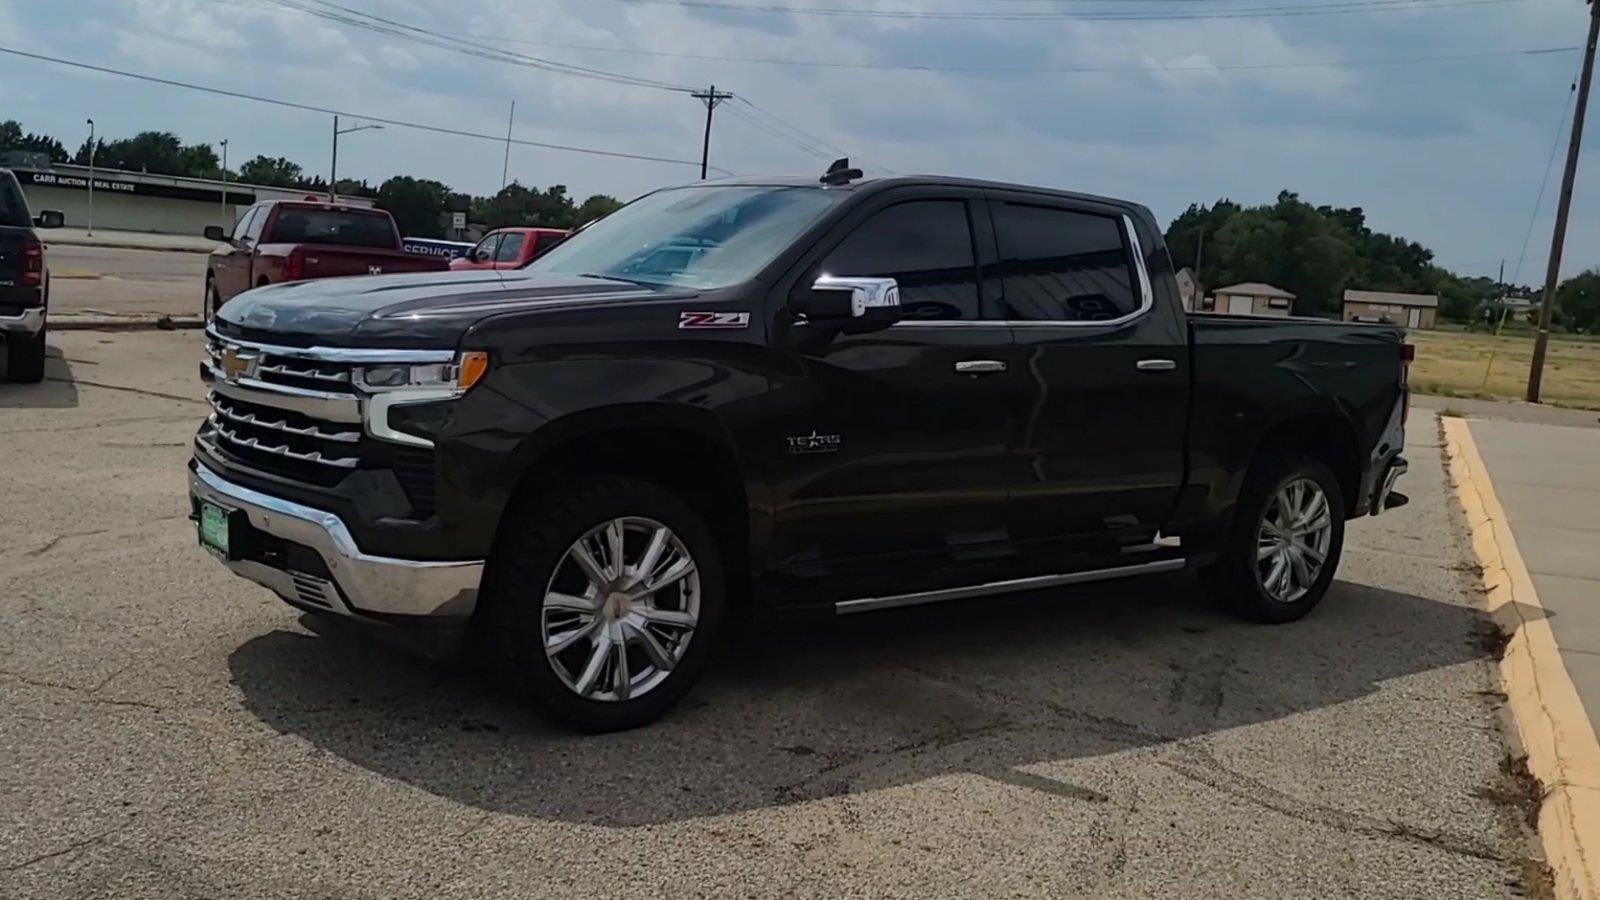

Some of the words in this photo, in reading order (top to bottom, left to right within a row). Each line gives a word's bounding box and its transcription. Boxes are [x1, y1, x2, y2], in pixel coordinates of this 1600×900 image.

[33, 174, 56, 183] CARR
[58, 177, 86, 186] AUCTION
[94, 181, 110, 189] REAL
[112, 183, 135, 191] ESTATE
[404, 244, 459, 259] SERVICE
[679, 312, 750, 329] Z71
[786, 430, 841, 447] TEXAS
